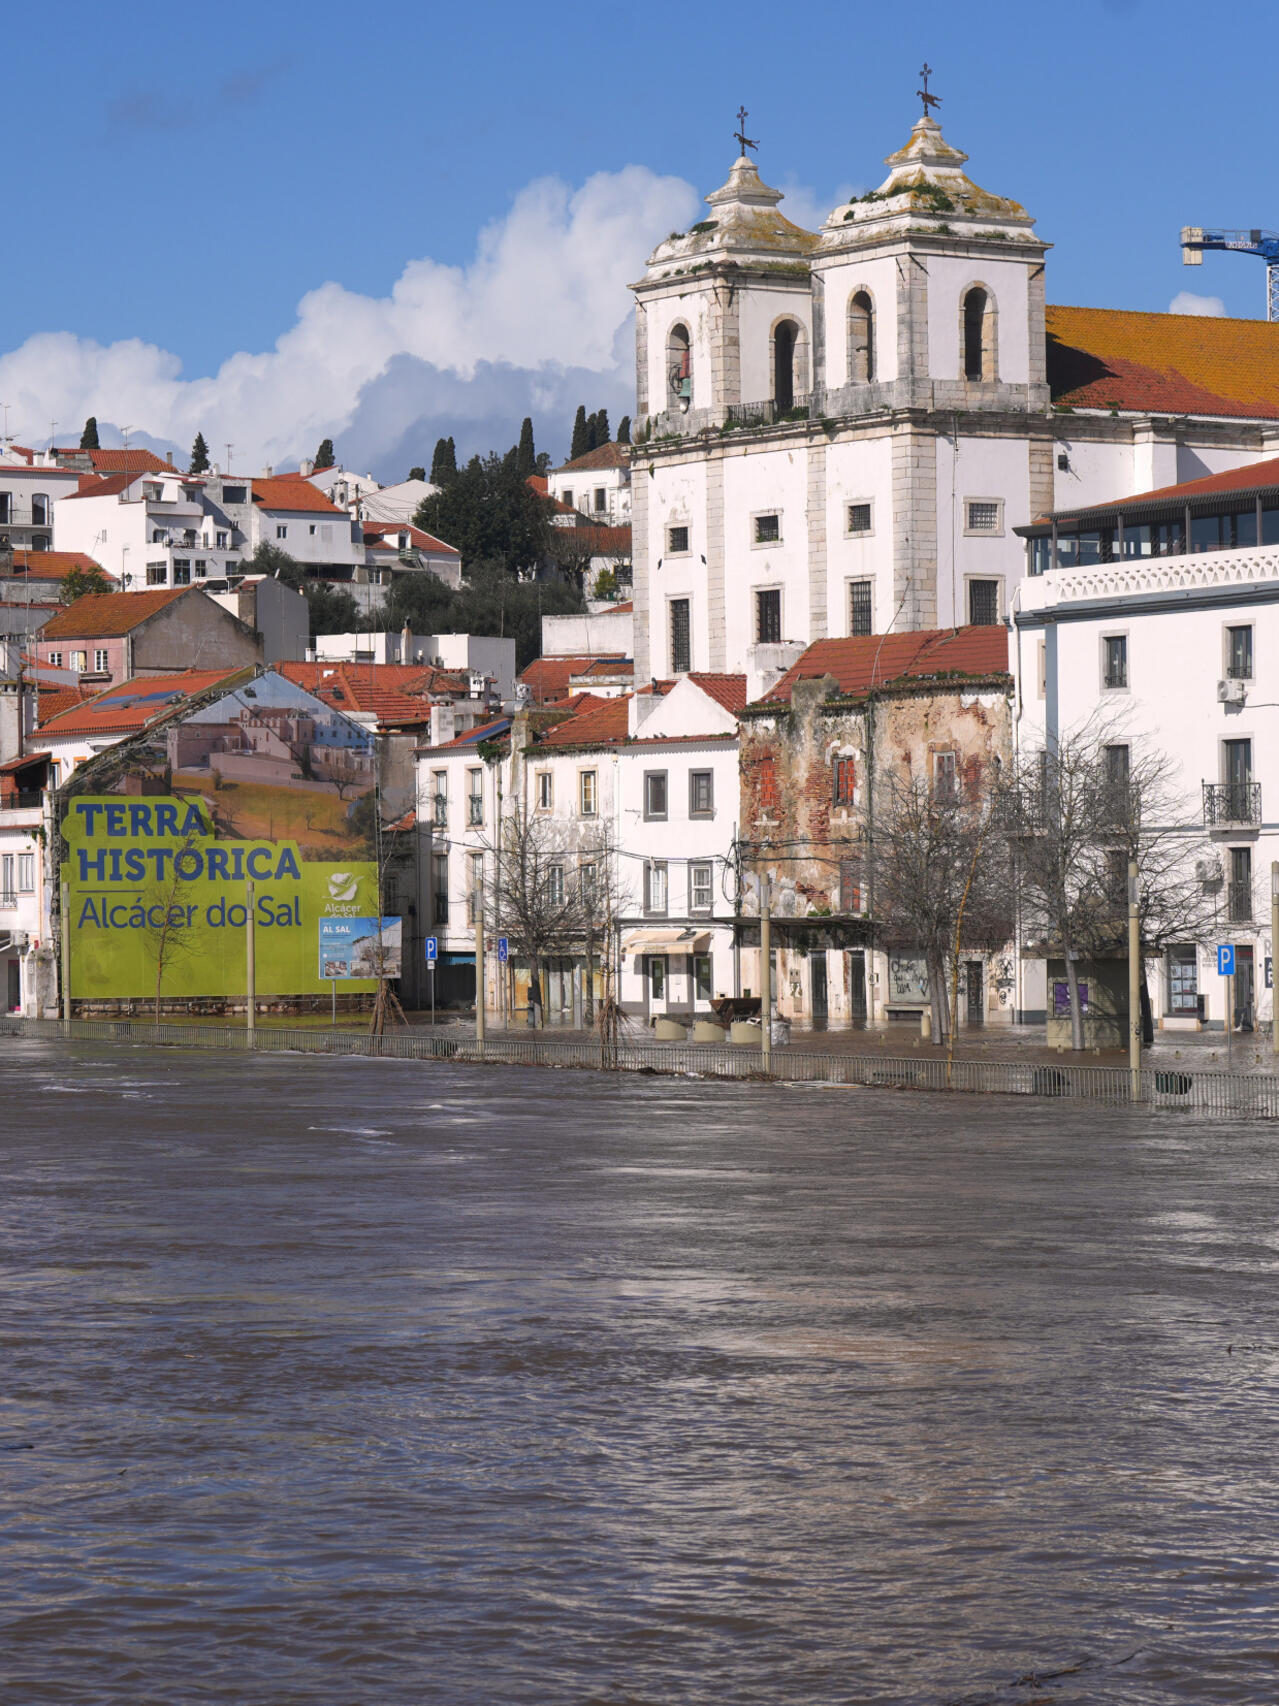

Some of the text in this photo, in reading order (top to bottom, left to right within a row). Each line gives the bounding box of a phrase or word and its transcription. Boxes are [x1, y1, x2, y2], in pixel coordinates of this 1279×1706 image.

[76, 803, 209, 837] TERRA
[77, 840, 301, 882] HISTÓRICA
[77, 896, 302, 929] Alcácer do Sal
[324, 903, 361, 912] Alcácer
[323, 925, 352, 933] AL SAL
[427, 940, 435, 959] P
[1221, 948, 1231, 973] P
